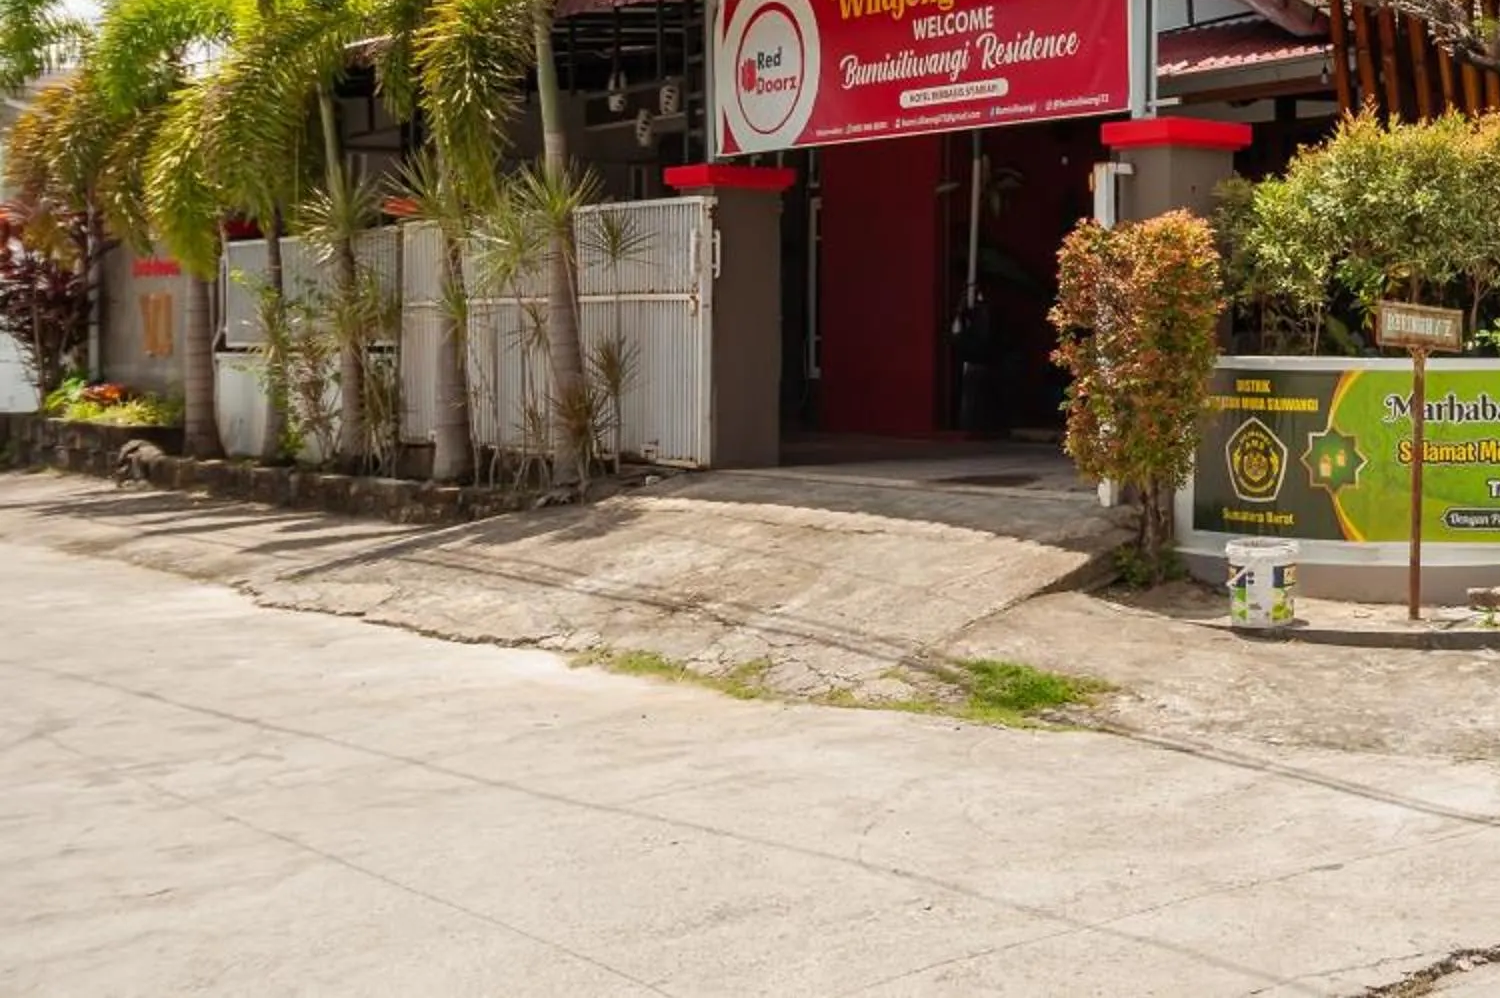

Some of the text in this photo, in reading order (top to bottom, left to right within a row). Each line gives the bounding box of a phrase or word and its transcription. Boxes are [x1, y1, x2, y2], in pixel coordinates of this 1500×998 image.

[913, 6, 994, 40] WELCOME
[757, 46, 782, 70] Red
[840, 30, 1080, 90] Bumisiliwangi Residence
[757, 76, 797, 94] Doorz
[1399, 439, 1476, 463] Slamat
